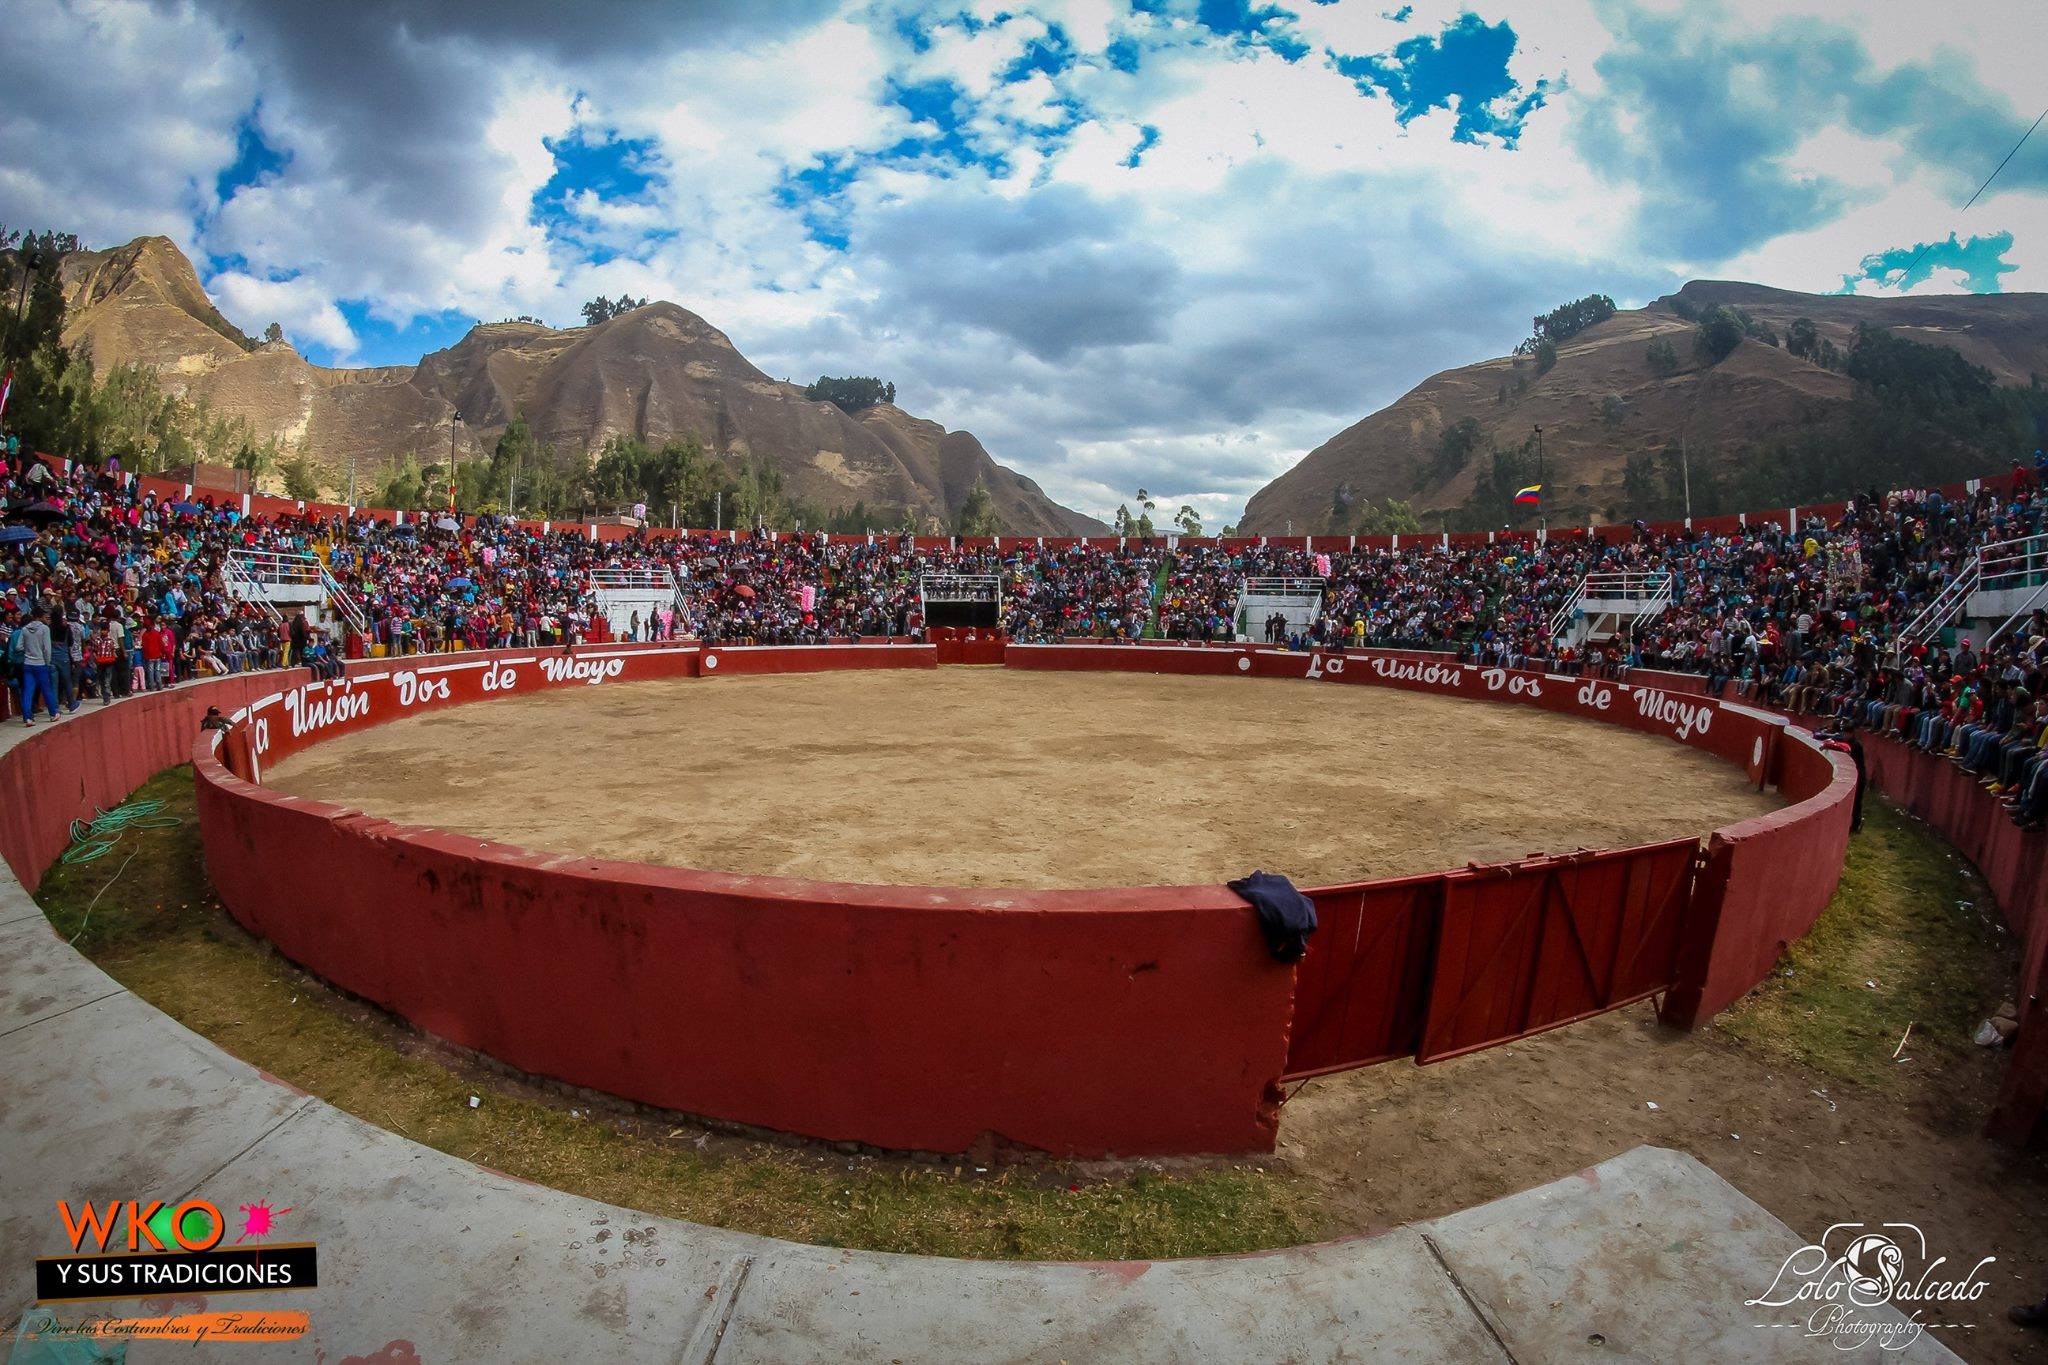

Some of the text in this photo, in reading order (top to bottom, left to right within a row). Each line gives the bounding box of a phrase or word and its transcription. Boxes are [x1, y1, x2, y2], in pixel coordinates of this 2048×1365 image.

[285, 679, 369, 737] Unión
[392, 669, 450, 706] Dos
[482, 660, 516, 691] de
[539, 656, 625, 685] Mayo
[1305, 654, 1713, 740] La Unión Dos de Mayo
